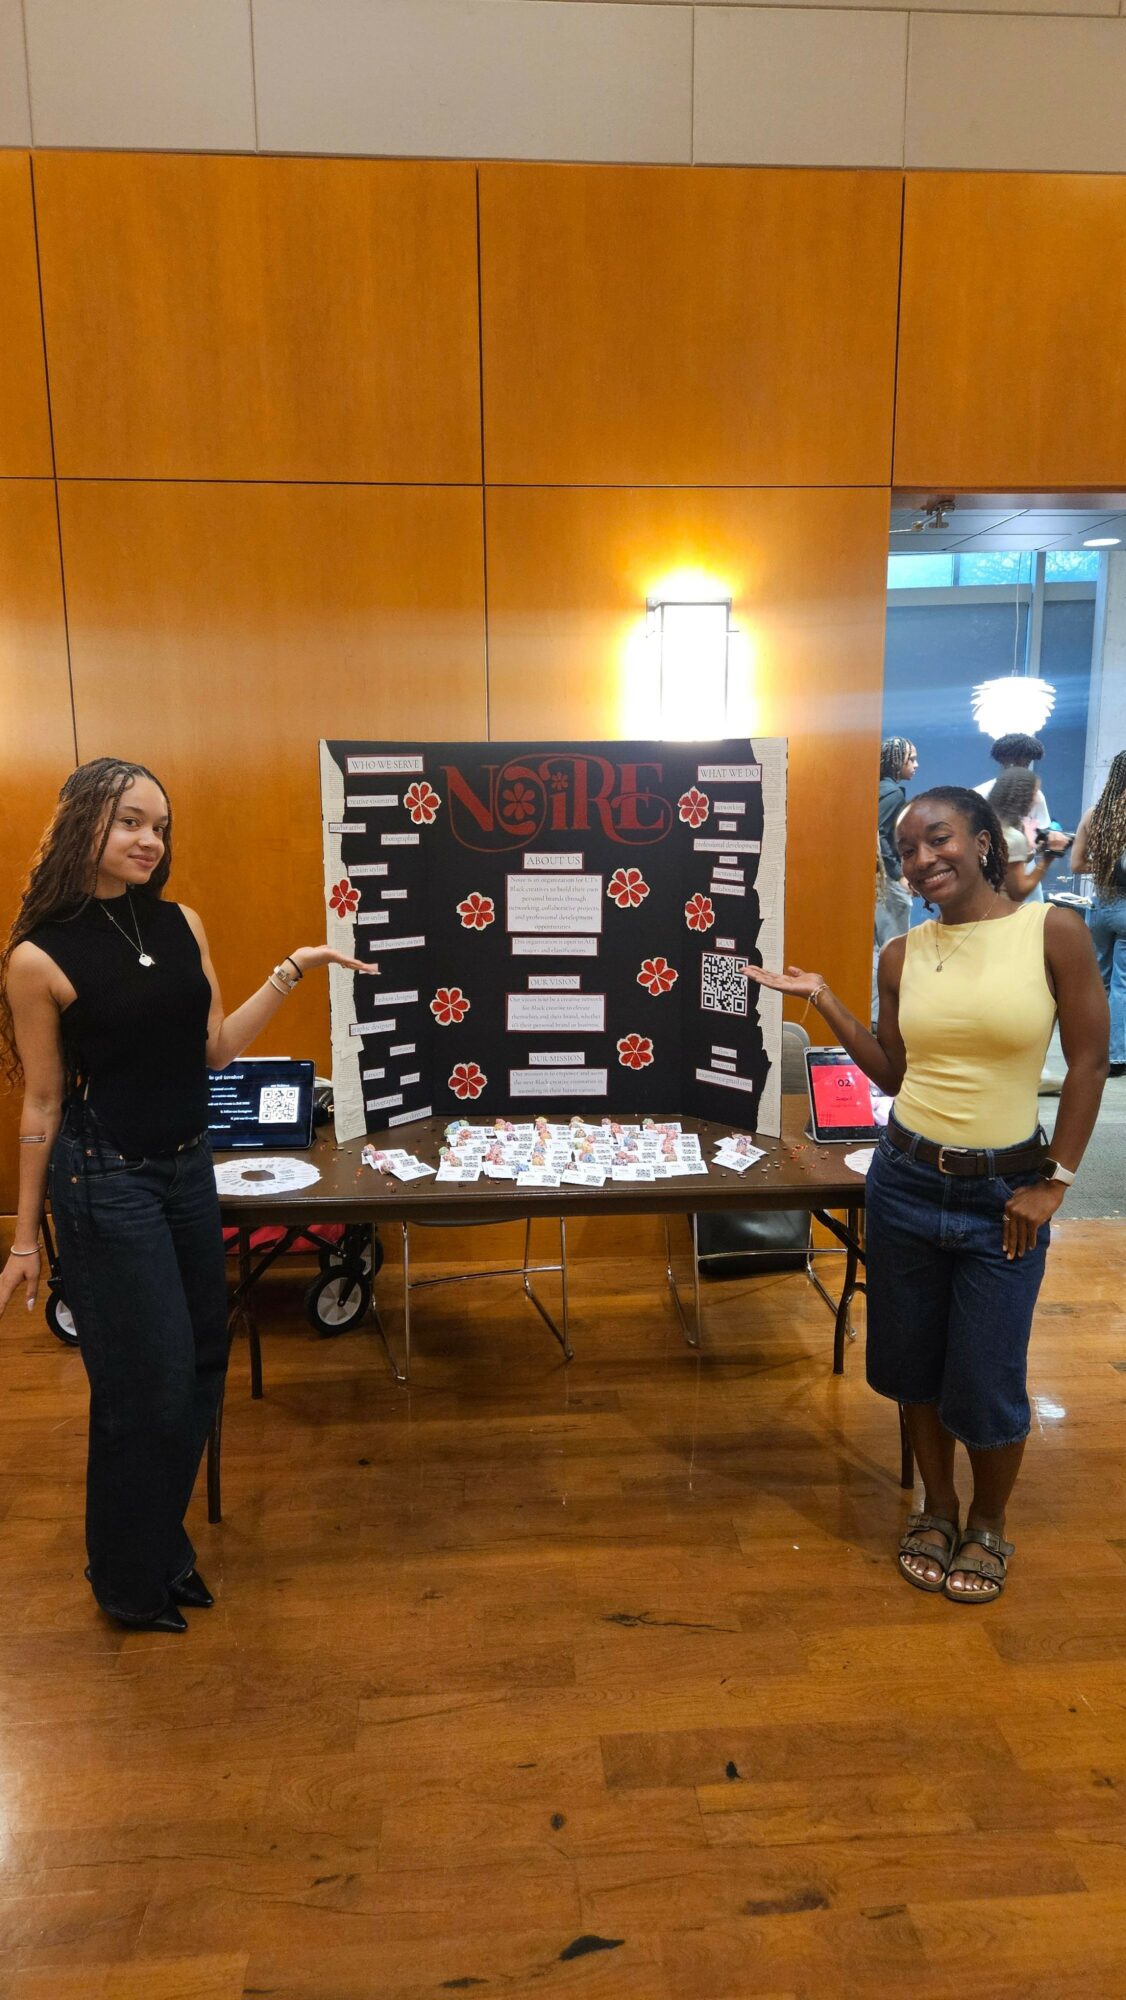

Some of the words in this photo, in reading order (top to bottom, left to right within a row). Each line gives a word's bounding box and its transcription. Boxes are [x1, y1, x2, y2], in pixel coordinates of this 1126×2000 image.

[352, 760, 376, 770] WHO
[377, 760, 391, 769] WE
[394, 760, 420, 768] SERVE
[700, 768, 726, 778] WHAT
[728, 768, 742, 777] WE
[745, 768, 759, 777] DO
[715, 804, 744, 812] networking
[382, 835, 418, 844] photographers
[696, 841, 725, 849] professional
[726, 841, 758, 850] development
[526, 856, 565, 865] ABOUT
[567, 856, 581, 865] US
[714, 870, 743, 880] mentorship
[515, 914, 525, 922] and
[526, 914, 557, 922] professional
[559, 914, 593, 922] development
[530, 978, 549, 986] OUR
[550, 978, 578, 986] VISION
[352, 1025, 369, 1034] graphic
[371, 1022, 394, 1031] designers
[837, 1078, 851, 1086] 02
[367, 1097, 402, 1108] videographers
[390, 1116, 408, 1126] creative
